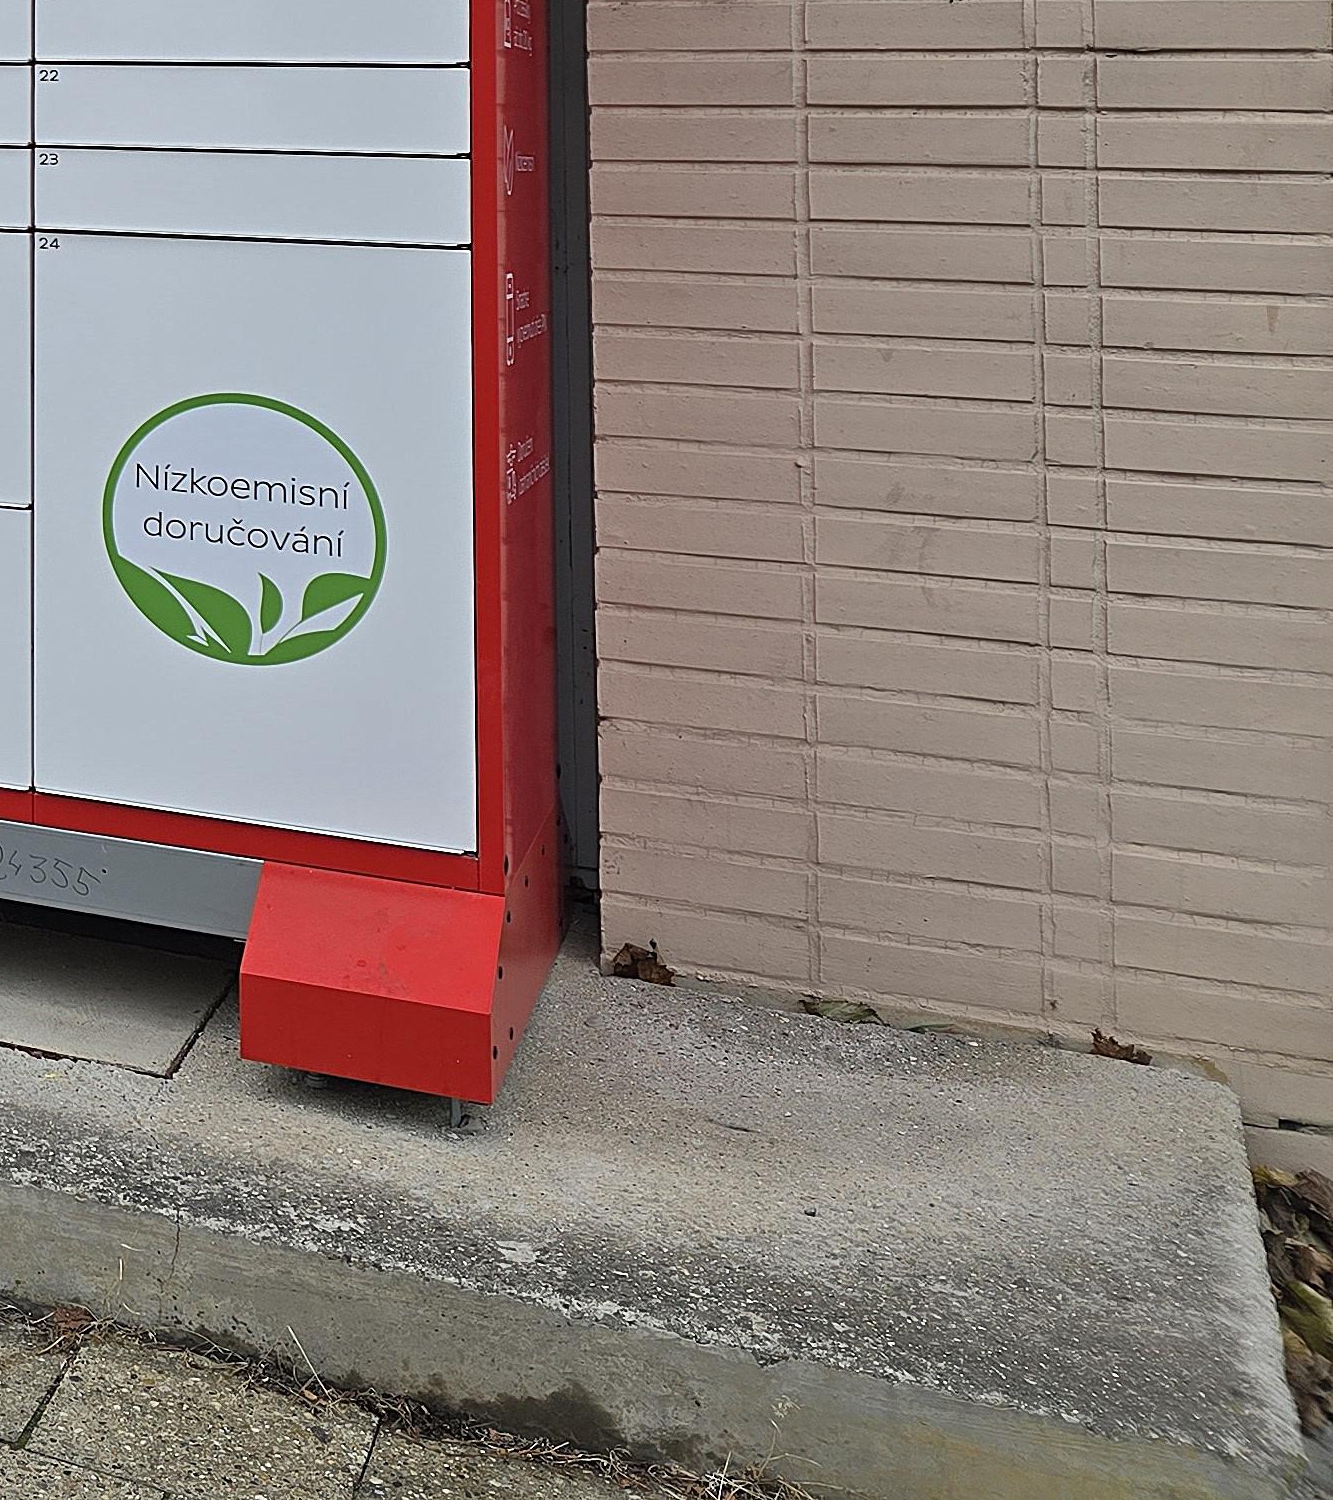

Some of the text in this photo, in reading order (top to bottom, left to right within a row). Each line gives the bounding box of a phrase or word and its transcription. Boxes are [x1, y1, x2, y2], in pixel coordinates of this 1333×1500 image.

[39, 70, 59, 82] 22
[39, 153, 59, 166] 23
[39, 238, 60, 250] 24
[136, 463, 350, 509] Nízkoemisní
[143, 511, 344, 557] doručování
